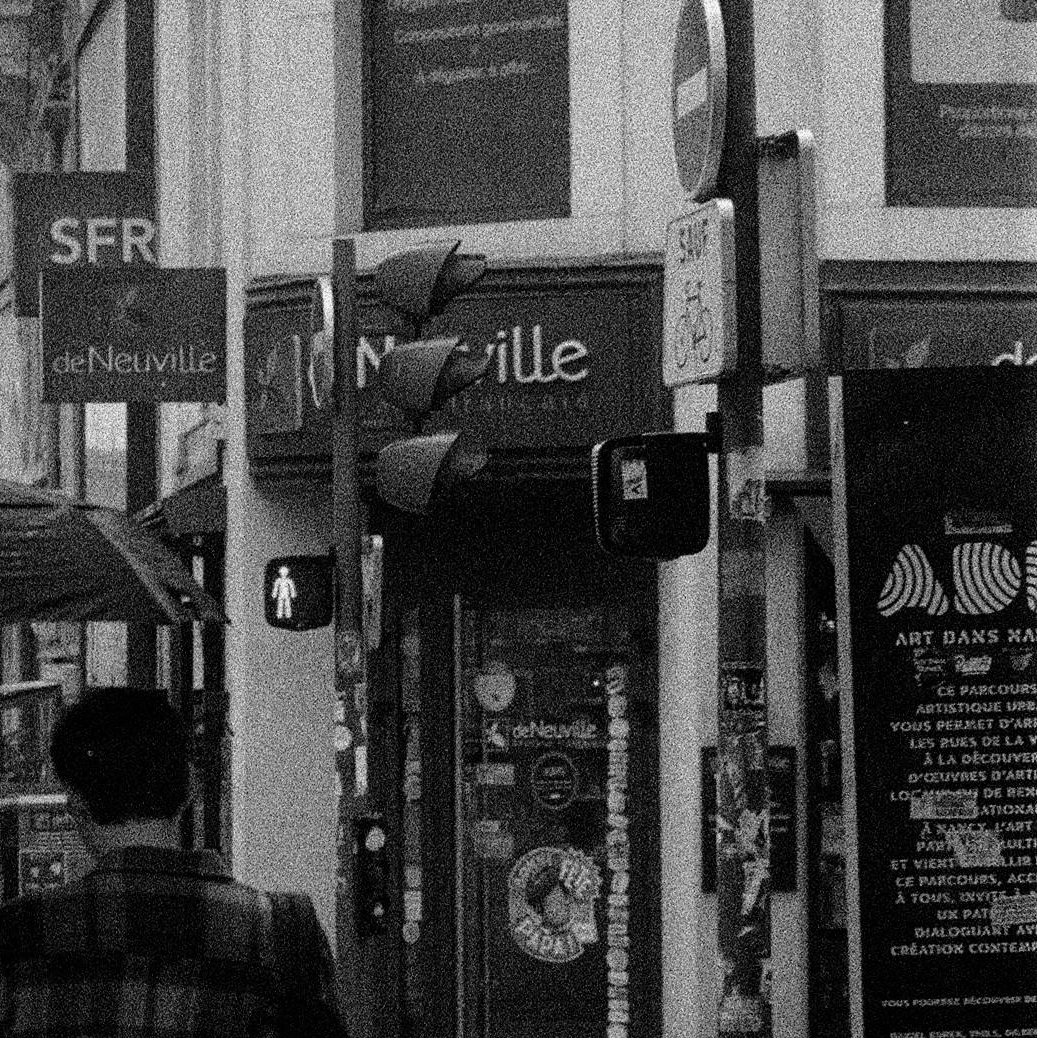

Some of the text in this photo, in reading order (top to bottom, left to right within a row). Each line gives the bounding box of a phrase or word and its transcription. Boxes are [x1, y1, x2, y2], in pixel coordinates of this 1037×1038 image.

[50, 217, 158, 264] SFR
[51, 344, 218, 374] deNeuville
[895, 627, 1037, 647] ART DANS NA
[936, 684, 1037, 697] CE PARCOURS
[916, 701, 1037, 715] ARTISTIQUE URB
[890, 722, 932, 732] VOUS
[936, 720, 994, 731] PERMET
[909, 738, 935, 749] LES
[939, 737, 977, 749] RUES
[981, 736, 1000, 747] DE
[1004, 736, 1025, 747] LA
[937, 754, 957, 766] LA
[982, 788, 1002, 799] DE
[1006, 787, 1037, 799] REN
[994, 821, 1033, 833] L'ART
[890, 860, 908, 871] ET
[913, 859, 955, 869] VIENT
[895, 877, 915, 887] CE
[936, 910, 959, 921] UN
[914, 926, 1011, 939] DIALOGUANT
[890, 943, 964, 956] CRÉATION
